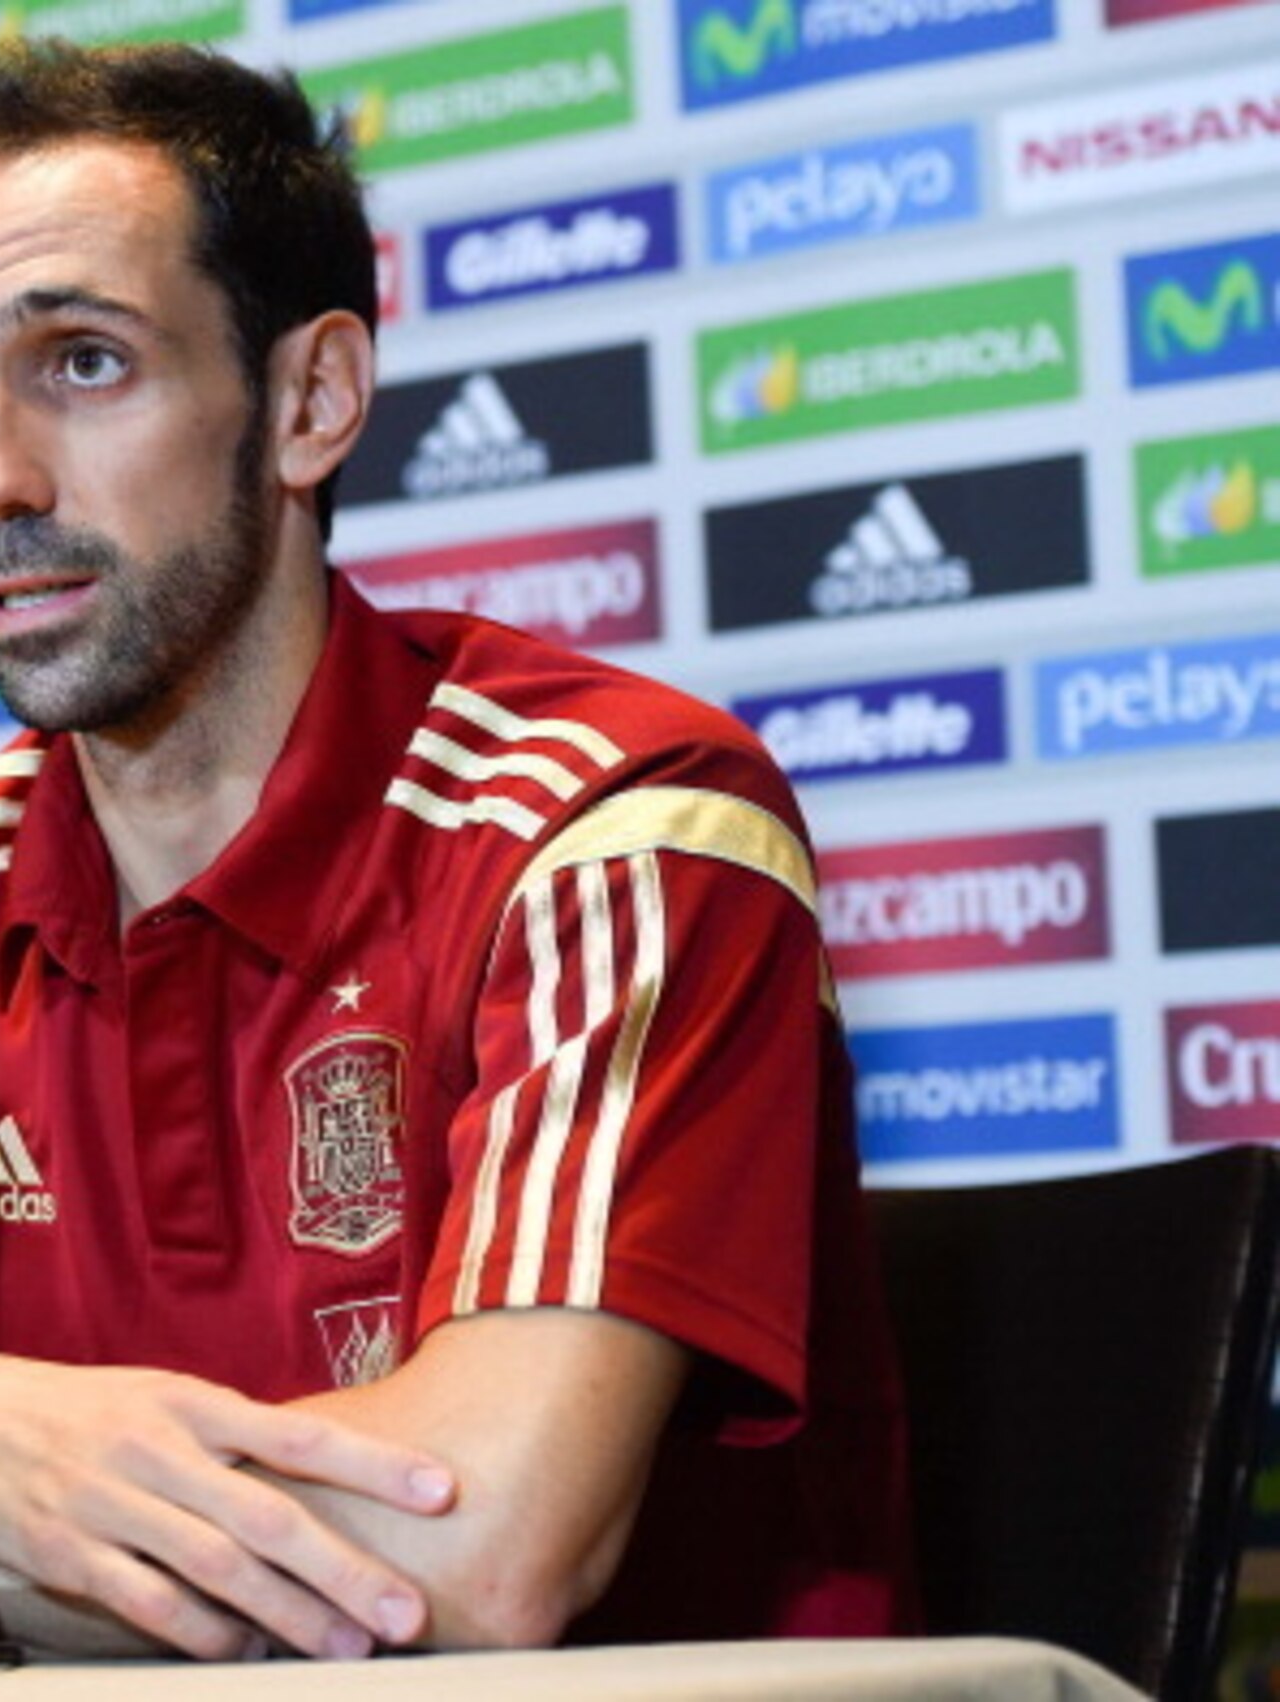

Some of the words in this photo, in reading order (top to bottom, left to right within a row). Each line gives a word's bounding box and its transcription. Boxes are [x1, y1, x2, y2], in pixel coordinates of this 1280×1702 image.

[725, 145, 955, 257] pelayo
[805, 320, 1065, 402] IBERDROLA
[1058, 647, 1280, 750] pelay
[858, 1054, 1107, 1122] movistar
